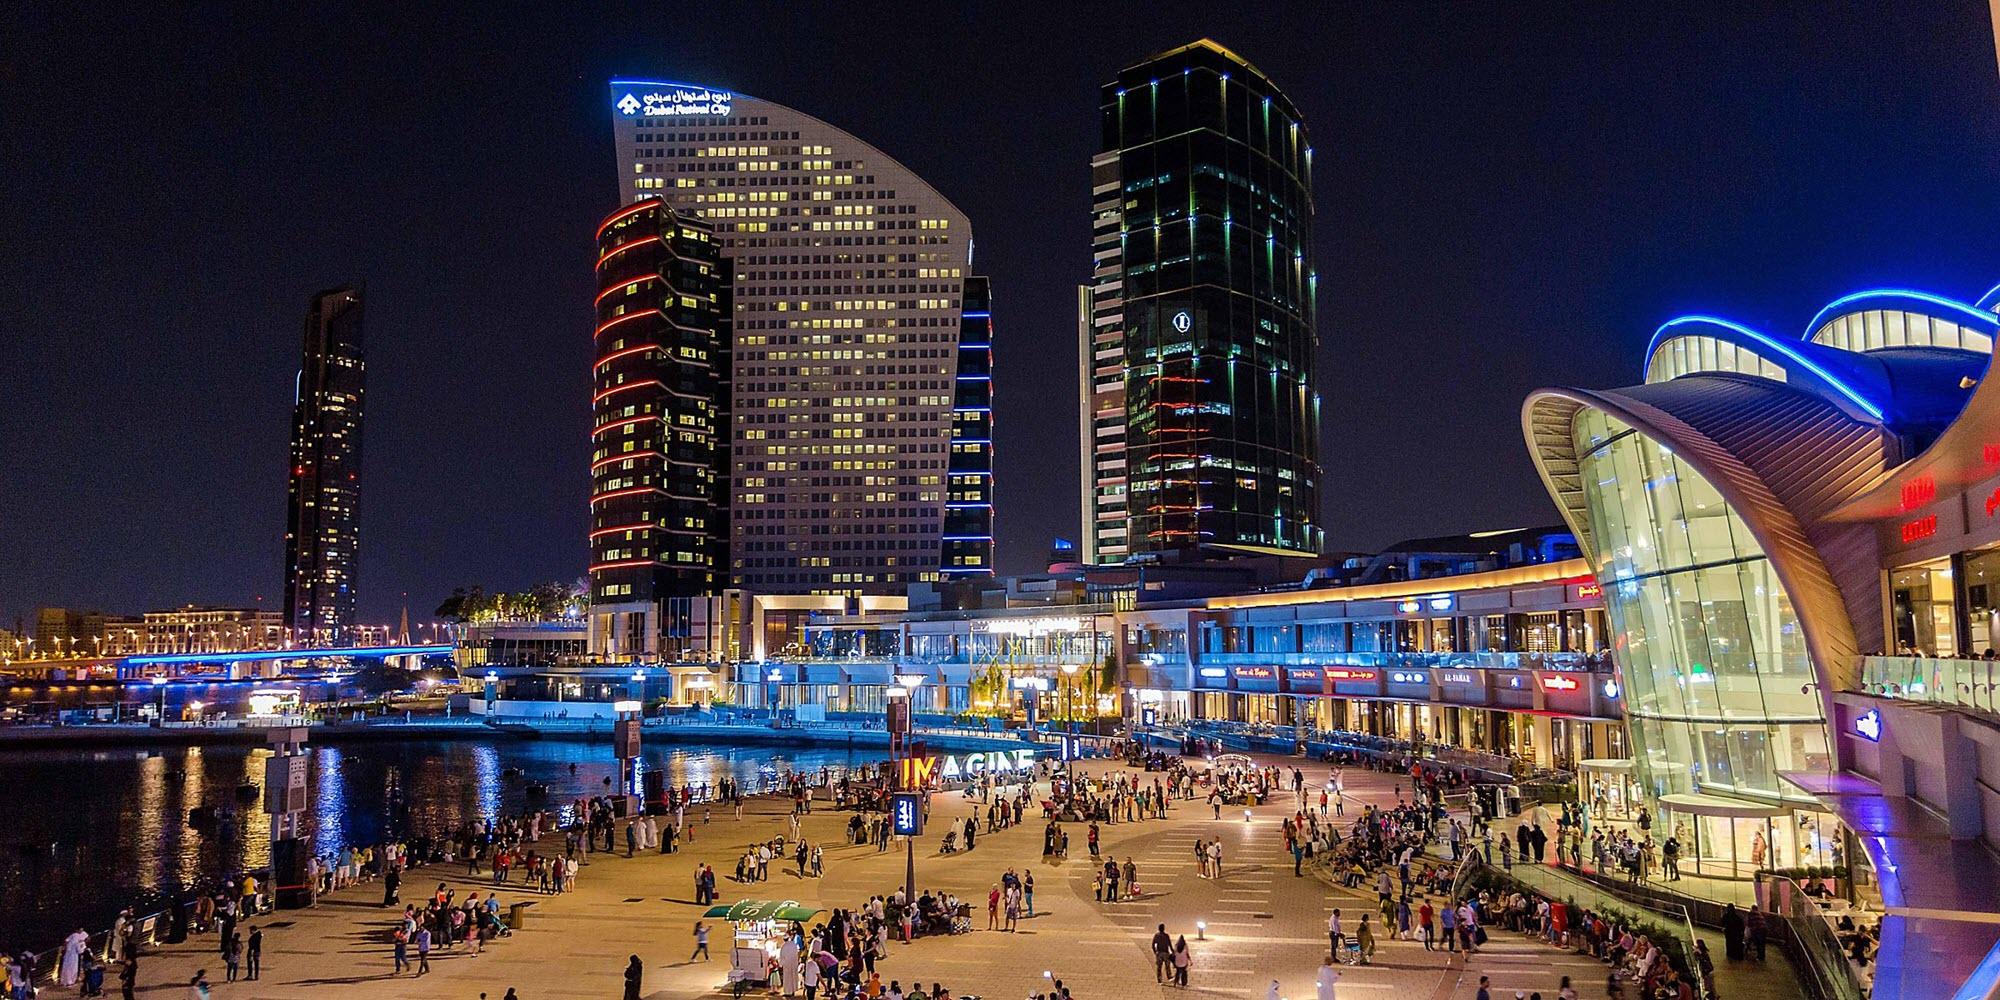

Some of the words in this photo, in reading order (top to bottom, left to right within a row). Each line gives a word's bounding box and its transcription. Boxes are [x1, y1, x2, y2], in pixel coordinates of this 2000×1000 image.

[643, 103, 675, 116] Dubai
[675, 103, 710, 115] Festival
[711, 103, 731, 116] City
[902, 749, 1035, 789] IMAGINE
